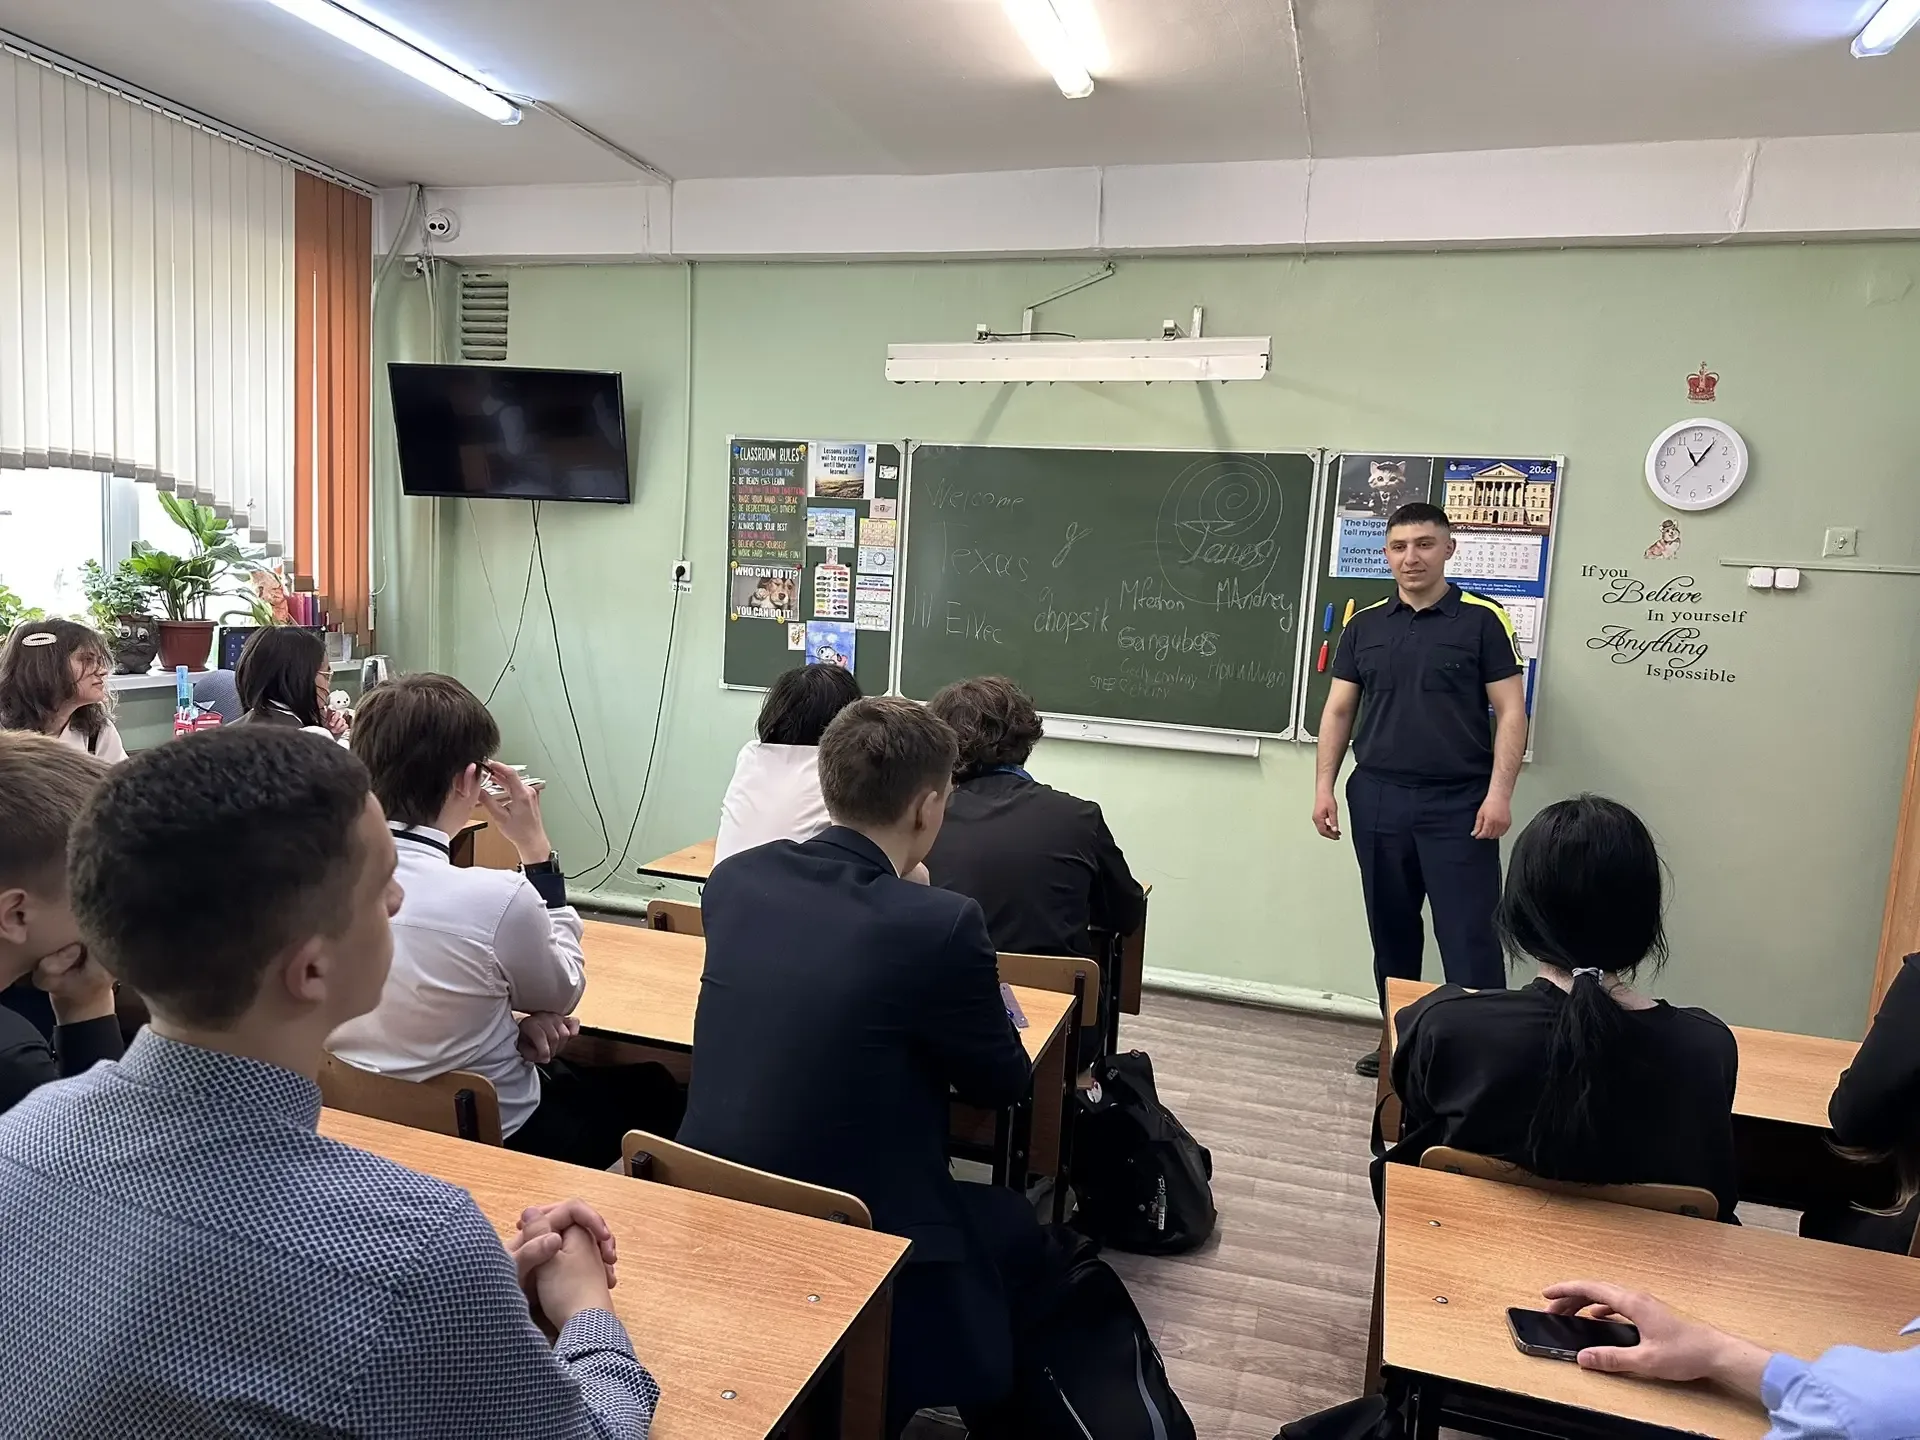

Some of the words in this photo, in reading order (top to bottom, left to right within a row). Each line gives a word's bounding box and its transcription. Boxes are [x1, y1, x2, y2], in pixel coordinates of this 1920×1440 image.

[1678, 437, 1686, 446] 11
[1694, 432, 1702, 442] 12
[740, 447, 776, 461] CLASSROOM
[780, 447, 799, 461] RULES
[1666, 447, 1676, 456] 10
[1722, 446, 1728, 456] 2
[1660, 460, 1666, 469] 9
[1726, 460, 1731, 470] 3
[762, 468, 774, 476] CLASS
[784, 468, 795, 476] TIME
[1529, 465, 1552, 474] 2026
[1664, 475, 1670, 484] 8
[1720, 475, 1725, 483] 4
[1675, 485, 1680, 494] 7
[1690, 489, 1696, 498] 6
[1707, 485, 1712, 493] 5
[924, 478, 1024, 512] Welcome
[785, 496, 797, 504] SPEAK
[739, 504, 743, 512] BE
[746, 504, 770, 512] RESPECTFUL
[780, 505, 796, 513] OTHERS
[1362, 520, 1387, 528] bigge
[738, 540, 754, 548] BELIEVE
[766, 541, 786, 549] YOURSELF
[752, 549, 762, 557] HARD
[930, 520, 1029, 582] Texas
[735, 567, 753, 576] WHO
[755, 568, 771, 577] CAN
[773, 569, 783, 578] DO
[785, 570, 798, 579] IT?
[1582, 565, 1597, 577] If
[1599, 569, 1628, 580] you
[1602, 576, 1702, 604] Believe
[736, 606, 751, 615] YOU
[754, 607, 768, 617] CAN
[771, 609, 780, 618] DO
[783, 610, 793, 618] IT!
[1648, 610, 1664, 621] In
[1672, 610, 1748, 623] yourself
[1586, 625, 1708, 668] Anything
[1646, 664, 1661, 676] Is
[1663, 668, 1736, 683] possible
